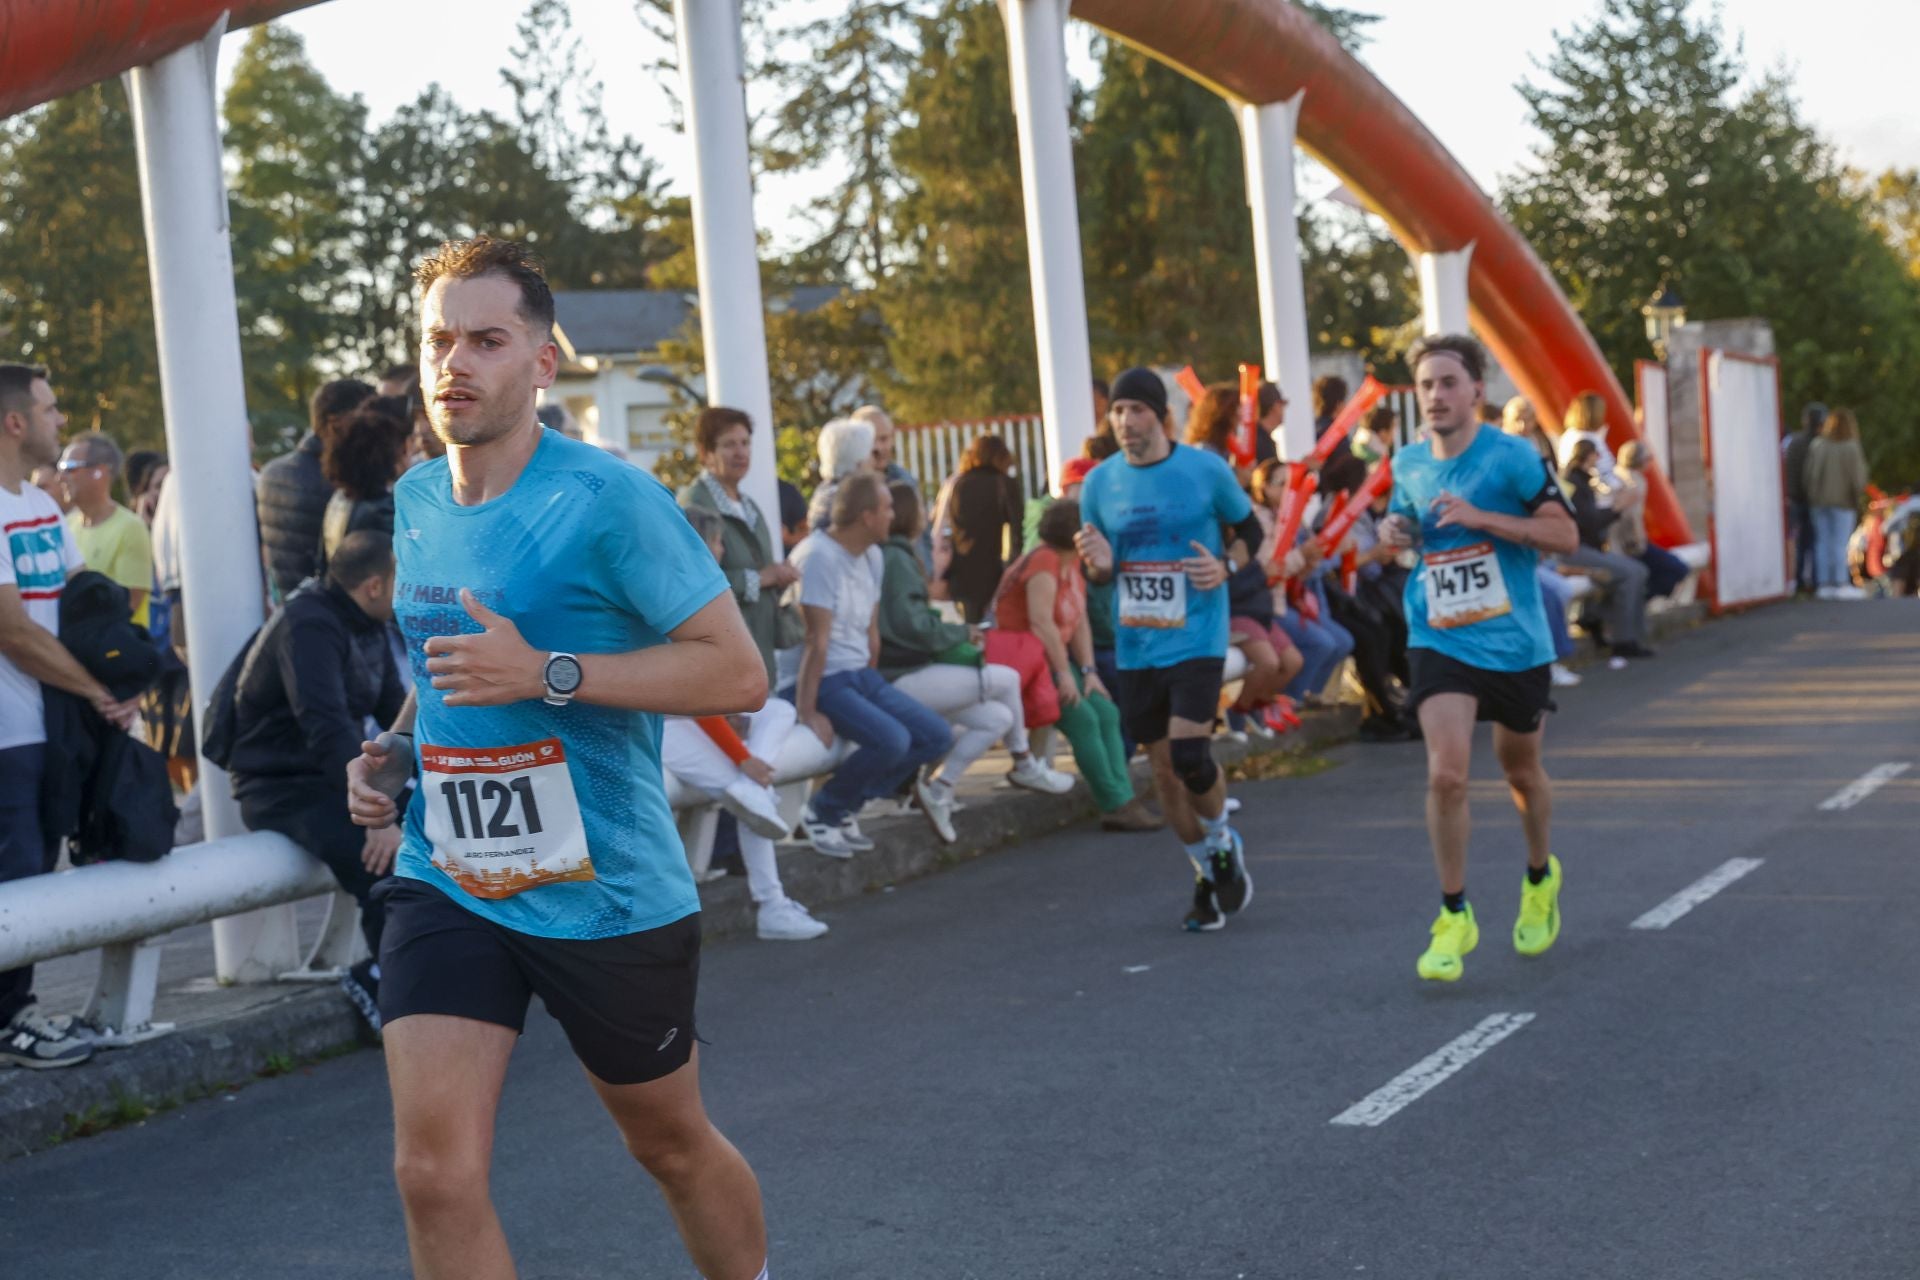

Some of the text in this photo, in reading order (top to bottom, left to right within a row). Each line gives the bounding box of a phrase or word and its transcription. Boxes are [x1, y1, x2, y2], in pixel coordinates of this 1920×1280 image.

[413, 585, 457, 604] MBA
[1124, 576, 1174, 601] 1339
[1431, 561, 1490, 598] 1475
[441, 776, 543, 839] 1121
